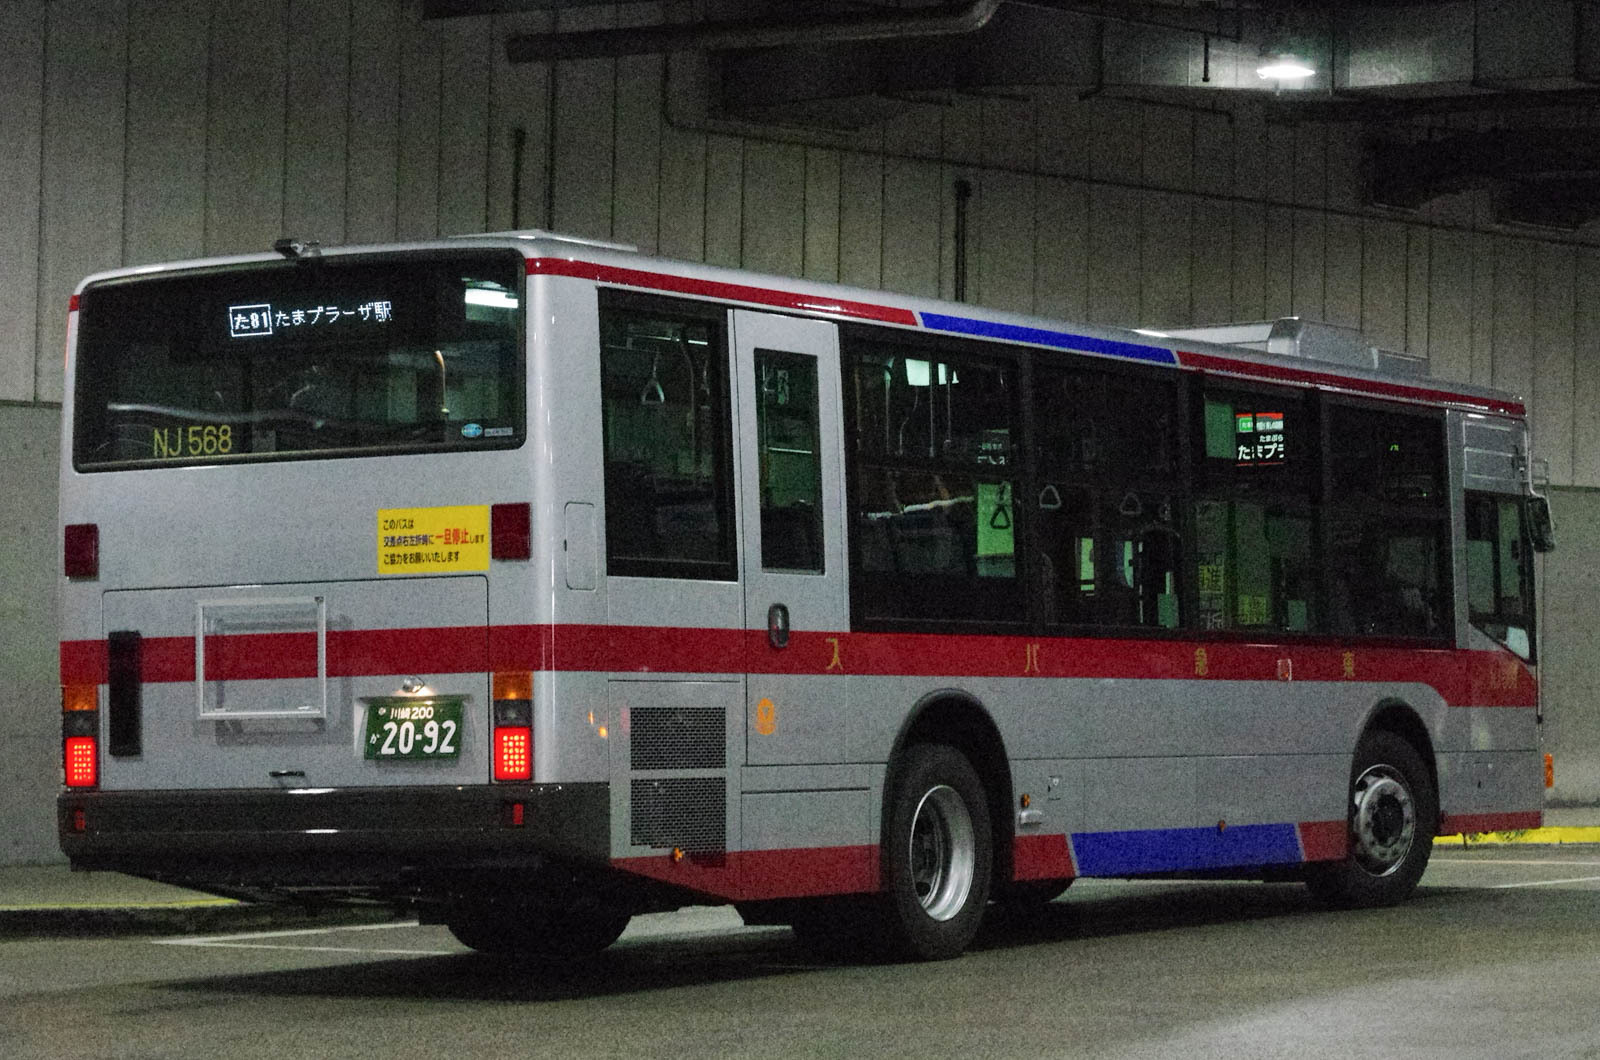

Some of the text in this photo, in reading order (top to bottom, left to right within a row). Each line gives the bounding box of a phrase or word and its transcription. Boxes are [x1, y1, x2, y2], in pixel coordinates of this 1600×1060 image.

[275, 301, 393, 327] たまプラーザ駅
[383, 519, 414, 531] このバスは
[380, 720, 457, 755] 20-92
